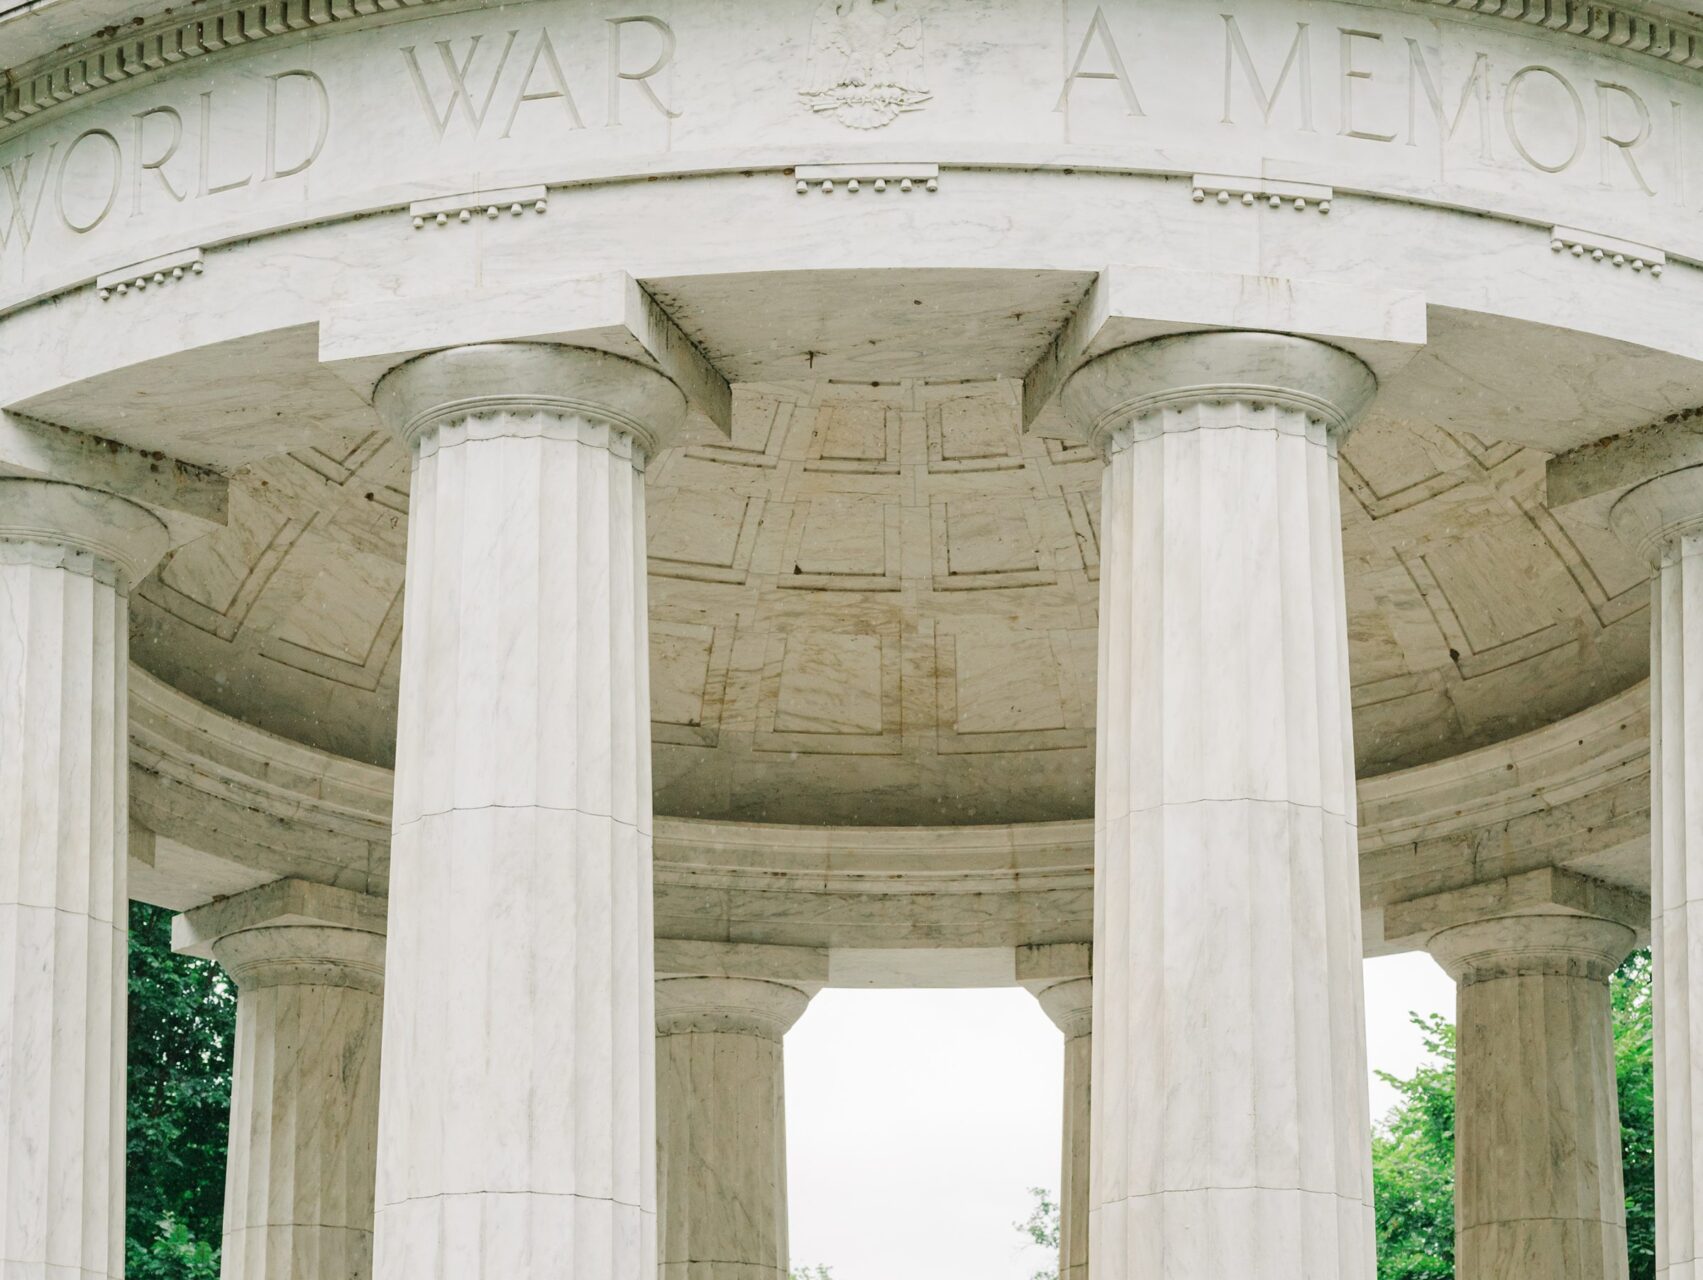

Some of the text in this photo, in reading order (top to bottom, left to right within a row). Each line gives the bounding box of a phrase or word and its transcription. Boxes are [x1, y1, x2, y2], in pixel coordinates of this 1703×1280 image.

[0, 69, 331, 256] WORLD
[400, 15, 683, 142] WAR
[1052, 5, 1147, 117] A
